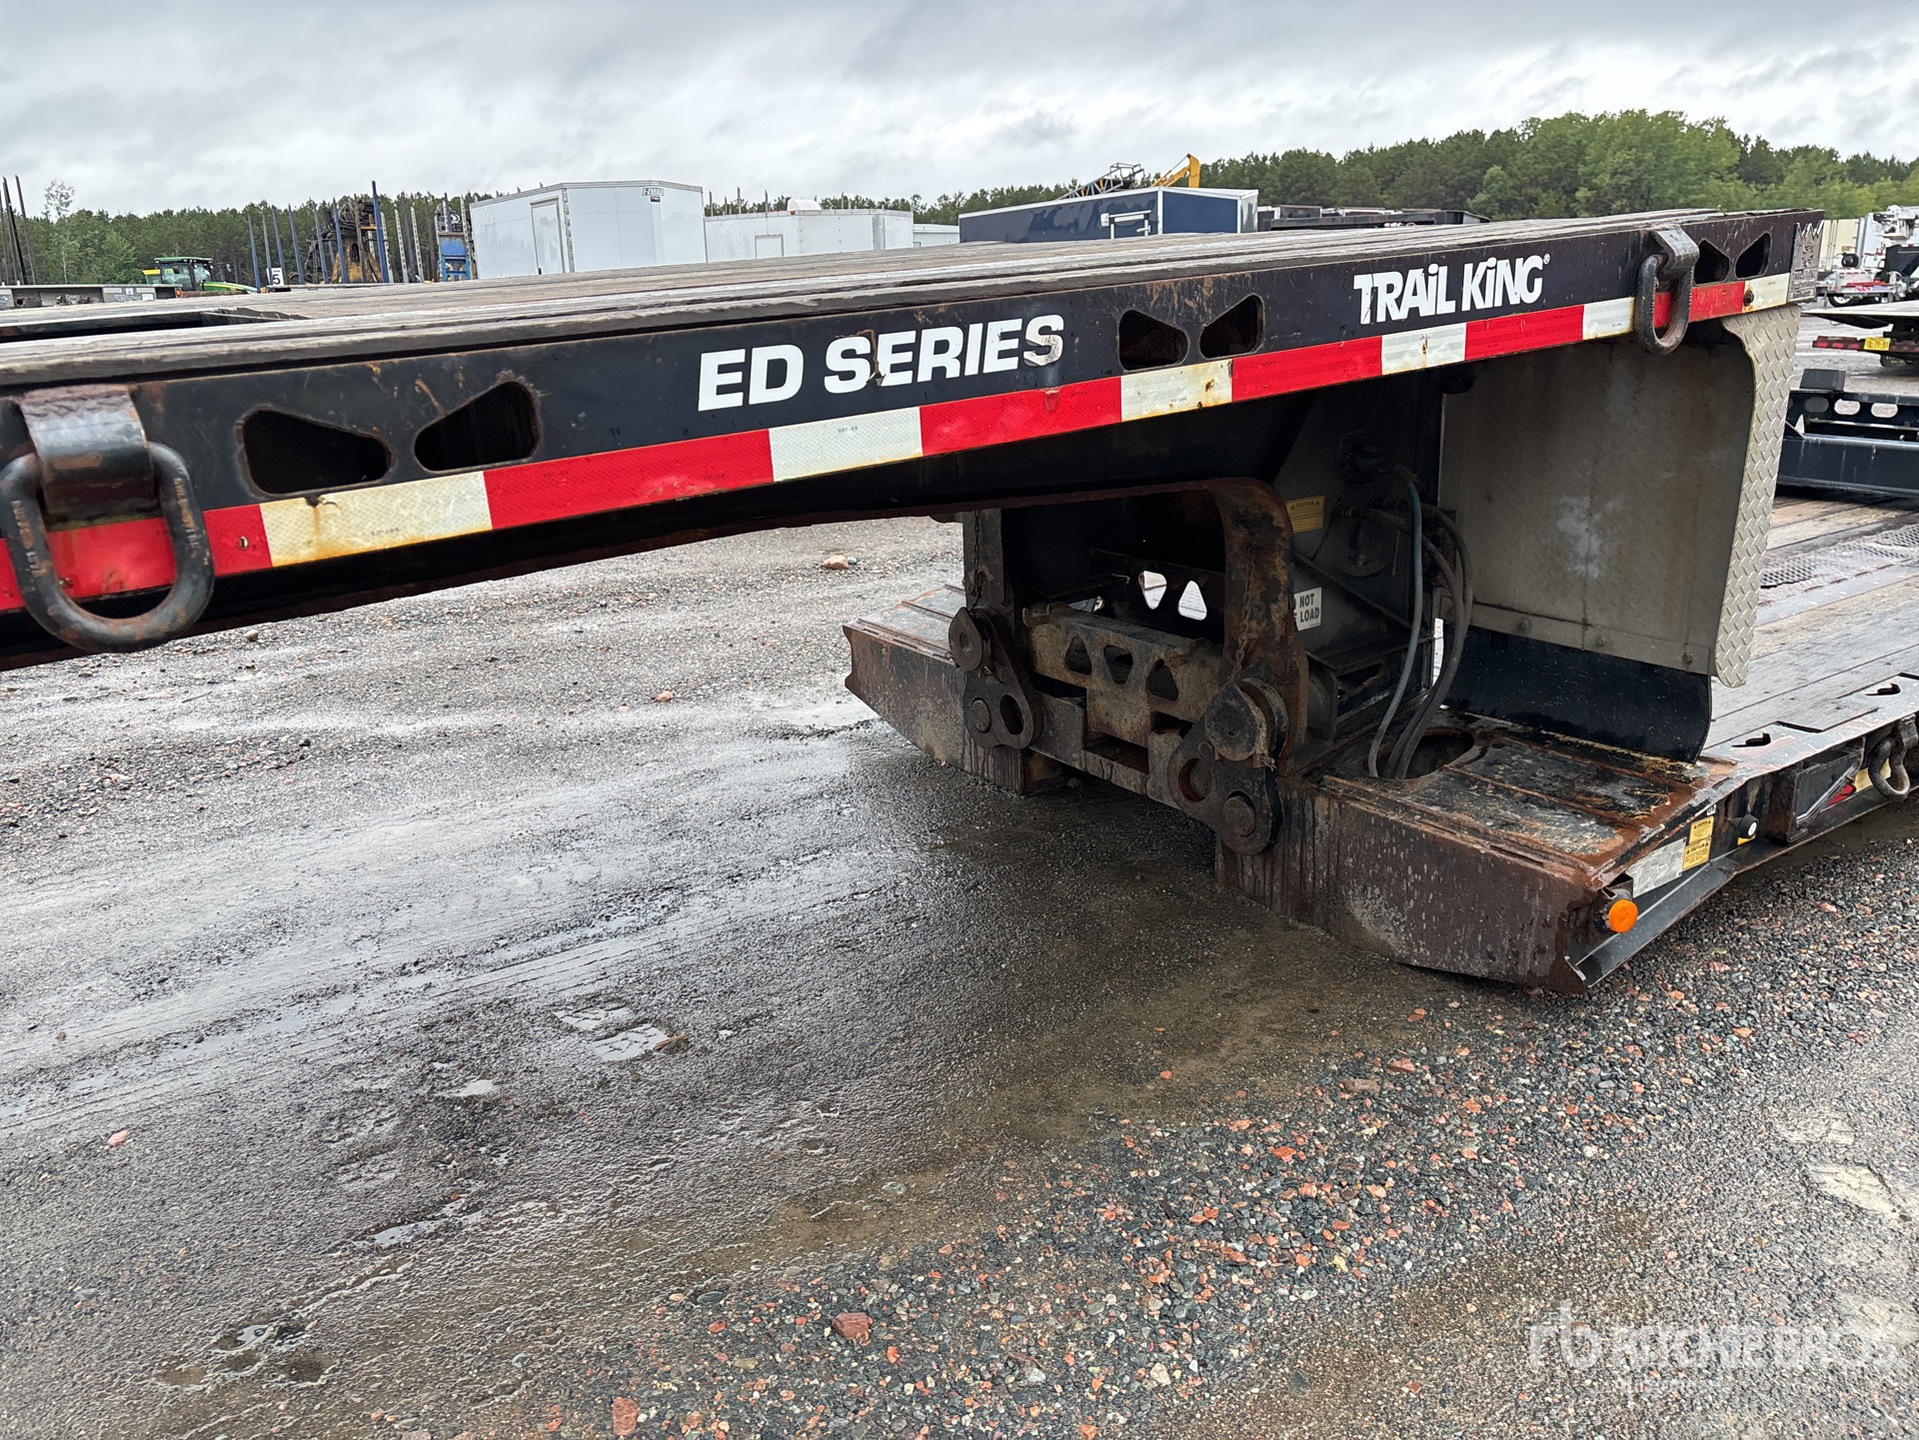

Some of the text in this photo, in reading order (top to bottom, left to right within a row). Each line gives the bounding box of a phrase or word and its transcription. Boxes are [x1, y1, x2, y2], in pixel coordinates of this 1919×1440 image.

[272, 274, 281, 285] 5
[698, 314, 1064, 412] ED SERIES
[1299, 593, 1315, 608] NOT
[1299, 607, 1320, 623] LOAD
